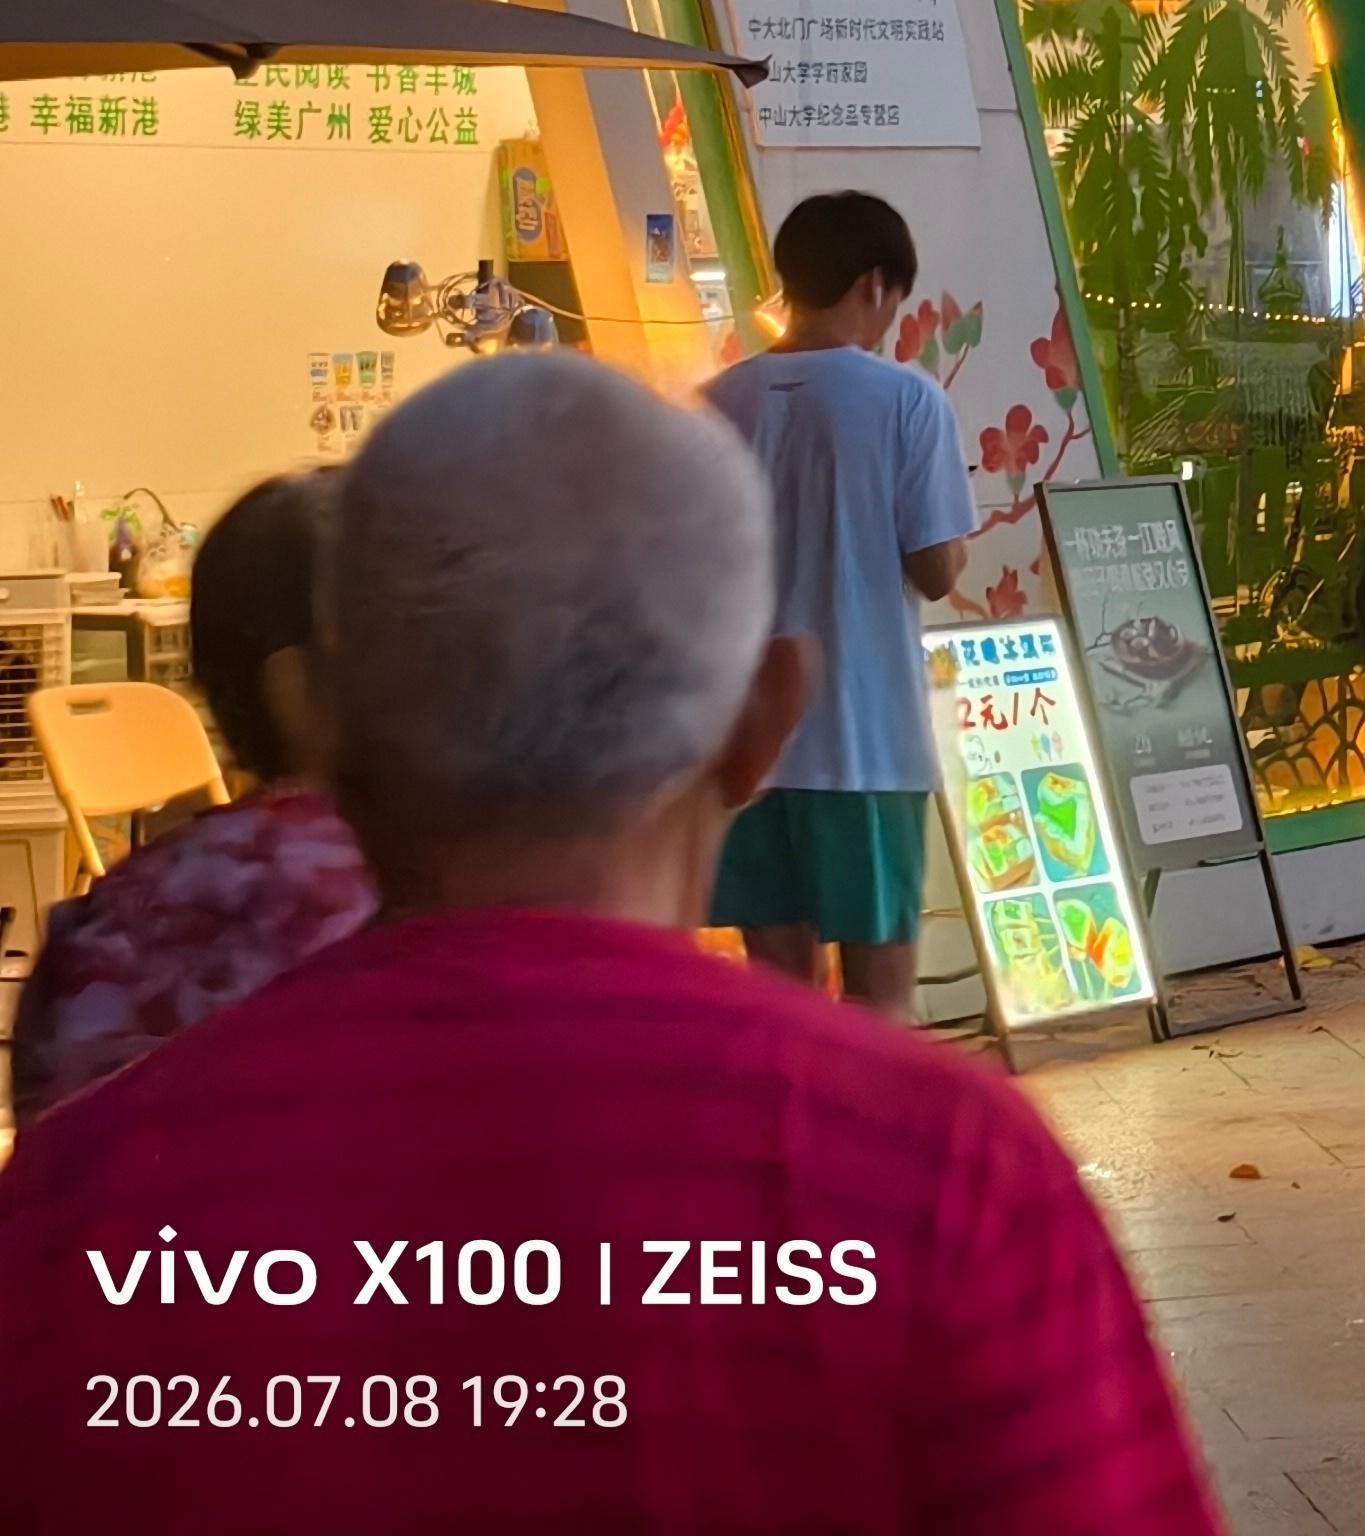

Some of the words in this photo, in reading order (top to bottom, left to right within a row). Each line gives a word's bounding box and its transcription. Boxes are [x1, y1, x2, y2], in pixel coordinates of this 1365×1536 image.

[748, 17, 945, 42] 中大北门广场新时代文明实践站
[234, 64, 351, 89] 民阅读
[768, 61, 868, 85] 山大学学府家园
[30, 93, 159, 137] 幸福新港
[233, 99, 351, 142] 绿美广州
[367, 105, 479, 146] 爱心公益
[759, 104, 901, 128] 中山大学纪念品专营店
